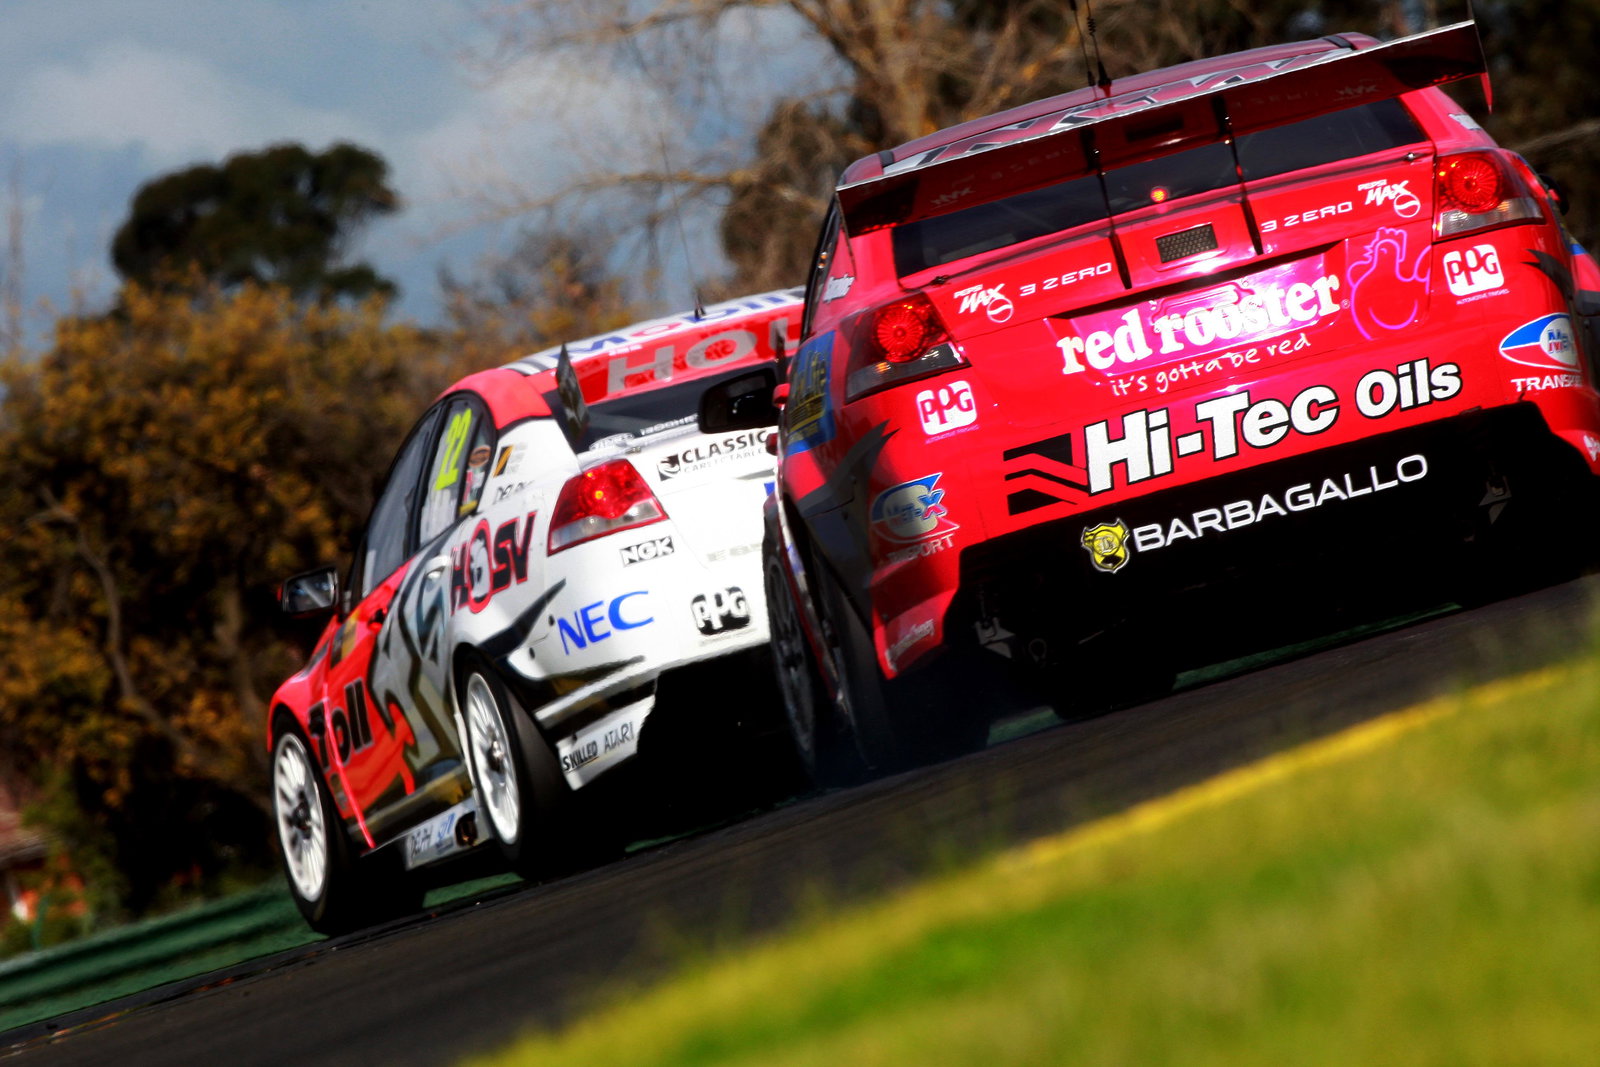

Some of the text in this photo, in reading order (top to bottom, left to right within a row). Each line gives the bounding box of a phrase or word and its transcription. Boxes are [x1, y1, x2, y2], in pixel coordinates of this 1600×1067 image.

[1364, 179, 1412, 206] MAX
[1260, 201, 1353, 233] 3 ZERO
[1019, 262, 1113, 297] 3 ZERO
[1445, 246, 1502, 290] PPG
[1056, 273, 1341, 376] red rooster
[1109, 332, 1312, 397] it's gotta be red
[918, 384, 976, 428] PPG
[1084, 357, 1462, 495] Hi-Tec Oils
[681, 429, 767, 464] CLASSIC
[1132, 454, 1428, 554] BARBAGALLO
[620, 536, 675, 566] NGK
[557, 590, 654, 656] NEC
[691, 586, 750, 634] PPG
[562, 740, 600, 772] SKILLED
